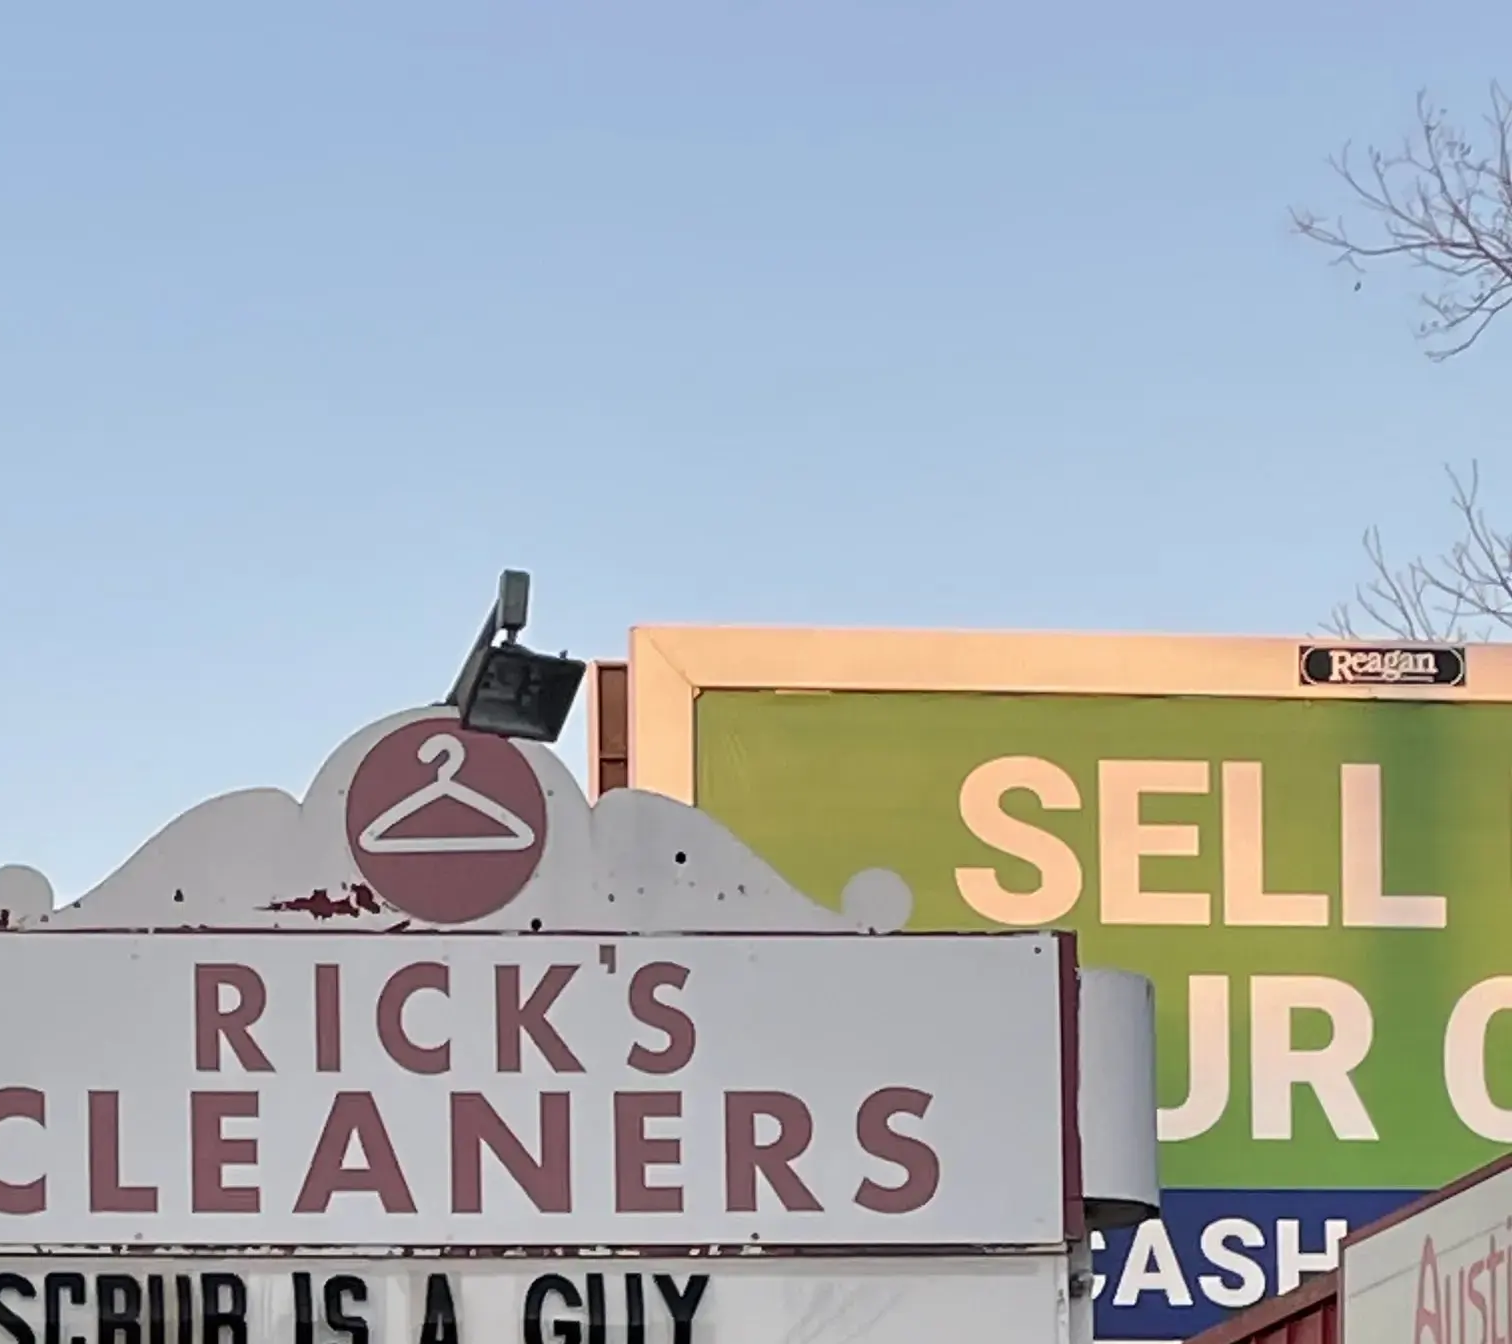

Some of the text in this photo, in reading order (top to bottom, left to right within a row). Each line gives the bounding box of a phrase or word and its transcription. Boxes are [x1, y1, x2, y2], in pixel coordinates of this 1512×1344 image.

[1328, 650, 1438, 682] Reagan
[955, 756, 1446, 928] SELL
[194, 945, 696, 1075] RICK'S
[1157, 975, 1378, 1141] UR
[1091, 1217, 1348, 1308] ASH
